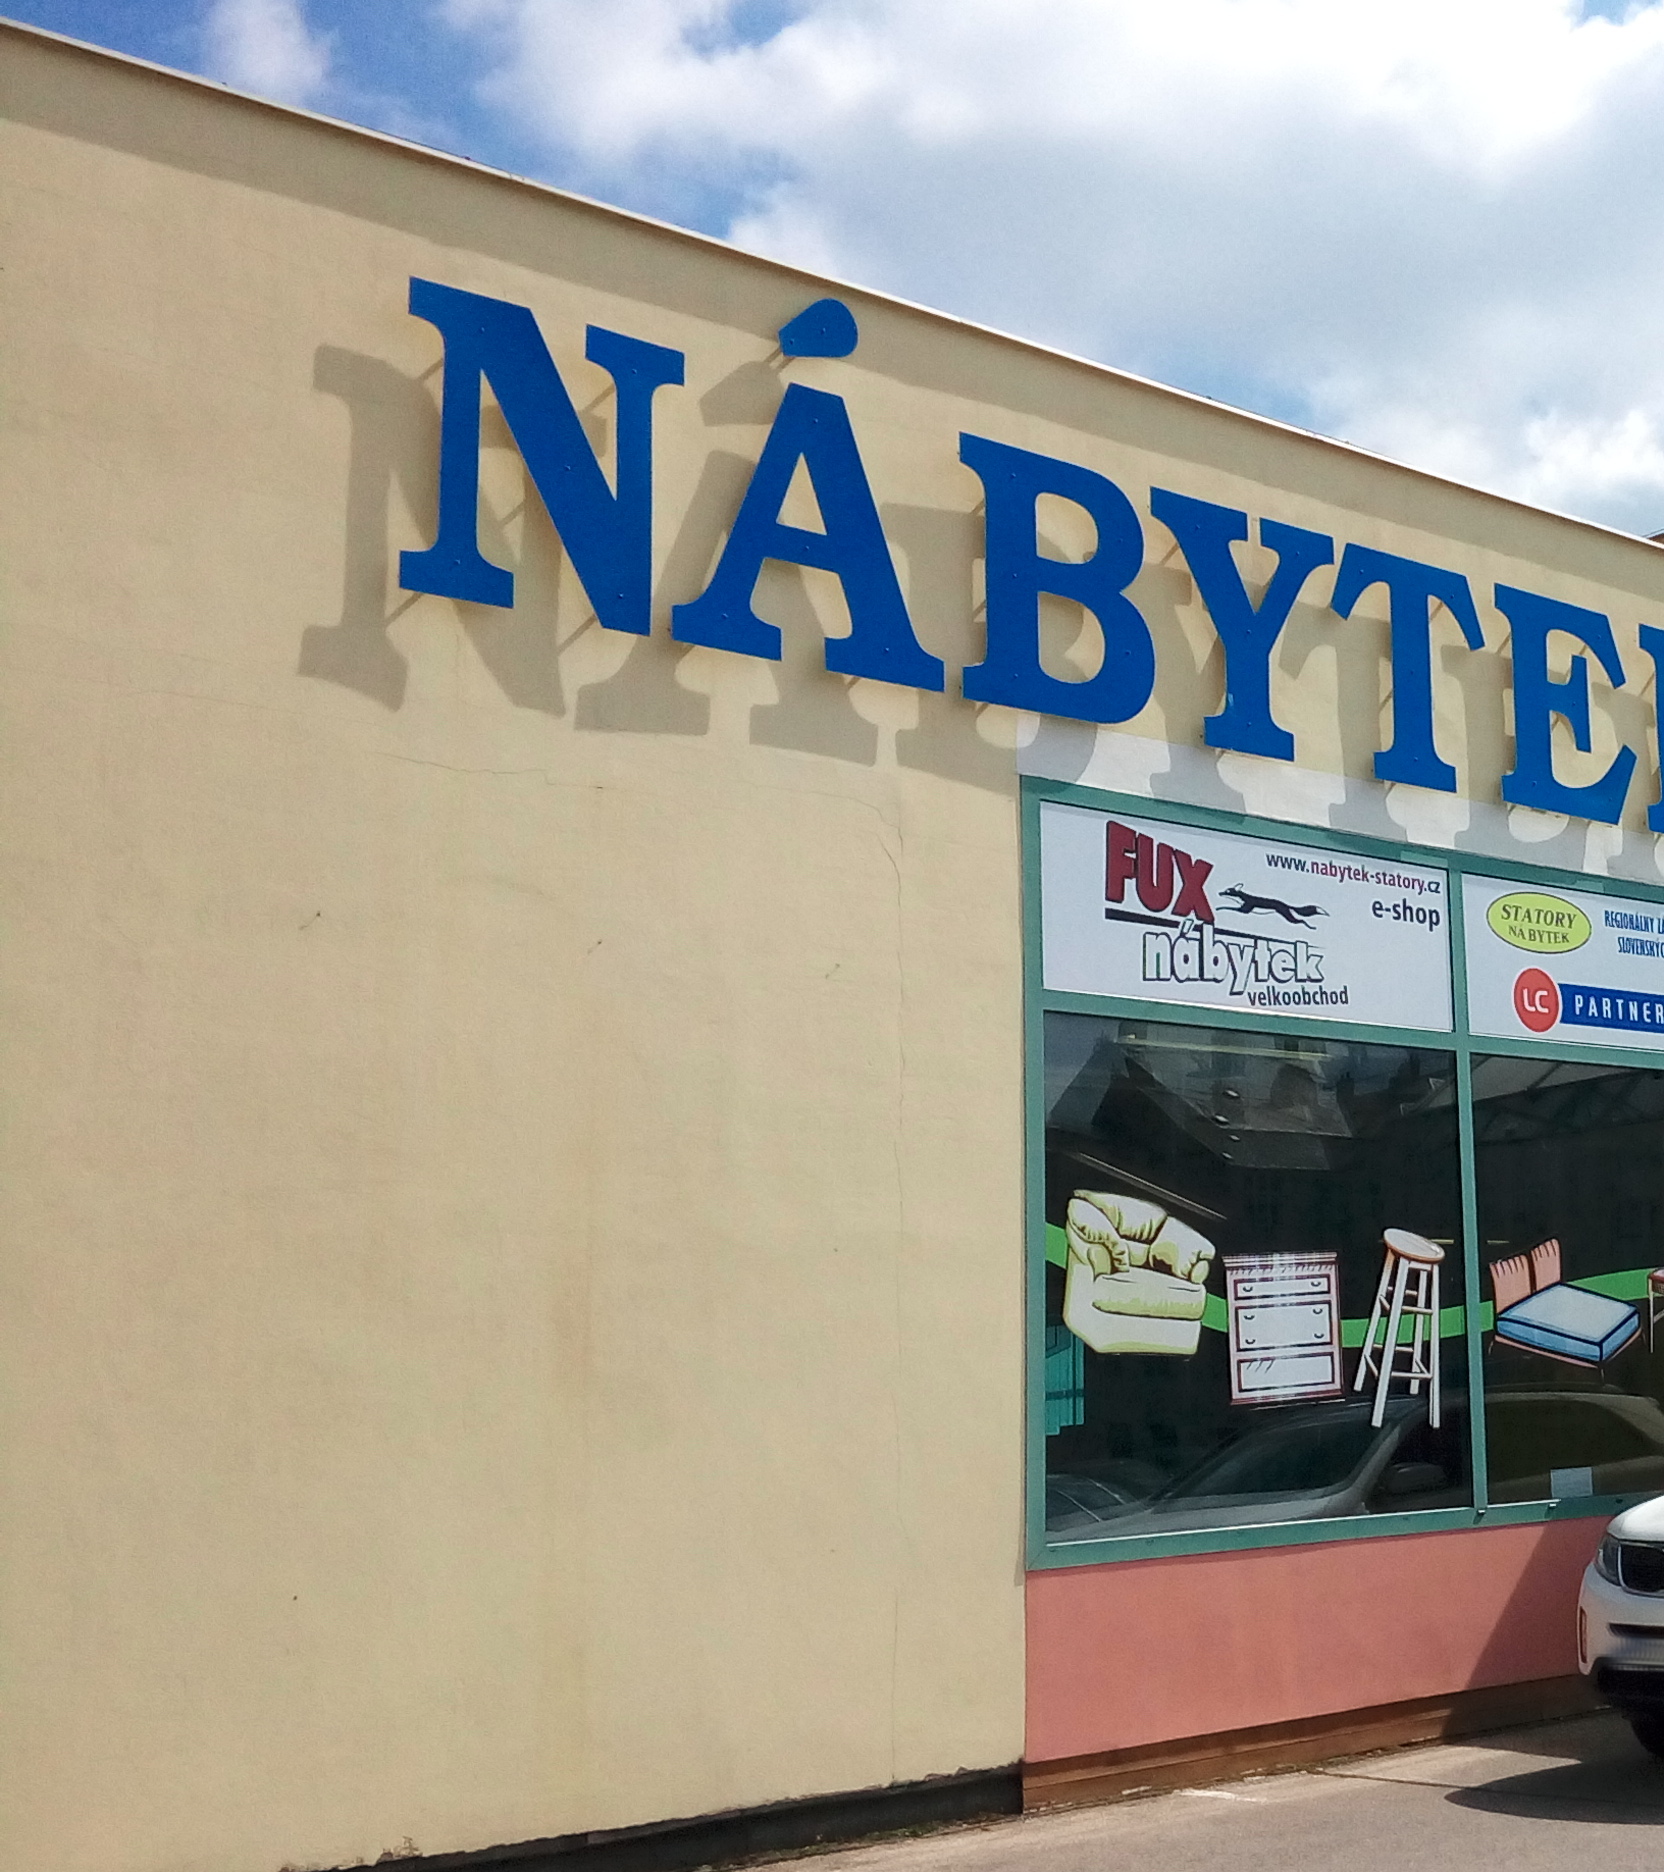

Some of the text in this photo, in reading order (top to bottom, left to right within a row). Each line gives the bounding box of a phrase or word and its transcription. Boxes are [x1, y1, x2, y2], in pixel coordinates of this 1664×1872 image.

[1106, 819, 1215, 923] FUX
[1265, 851, 1442, 895] www.nabytek-statory.cz
[1371, 897, 1441, 932] e-shop
[1500, 903, 1578, 930] STATORY
[1142, 918, 1326, 996] nábytek
[1248, 985, 1349, 1007] velkoobchod
[1522, 987, 1549, 1014] LC
